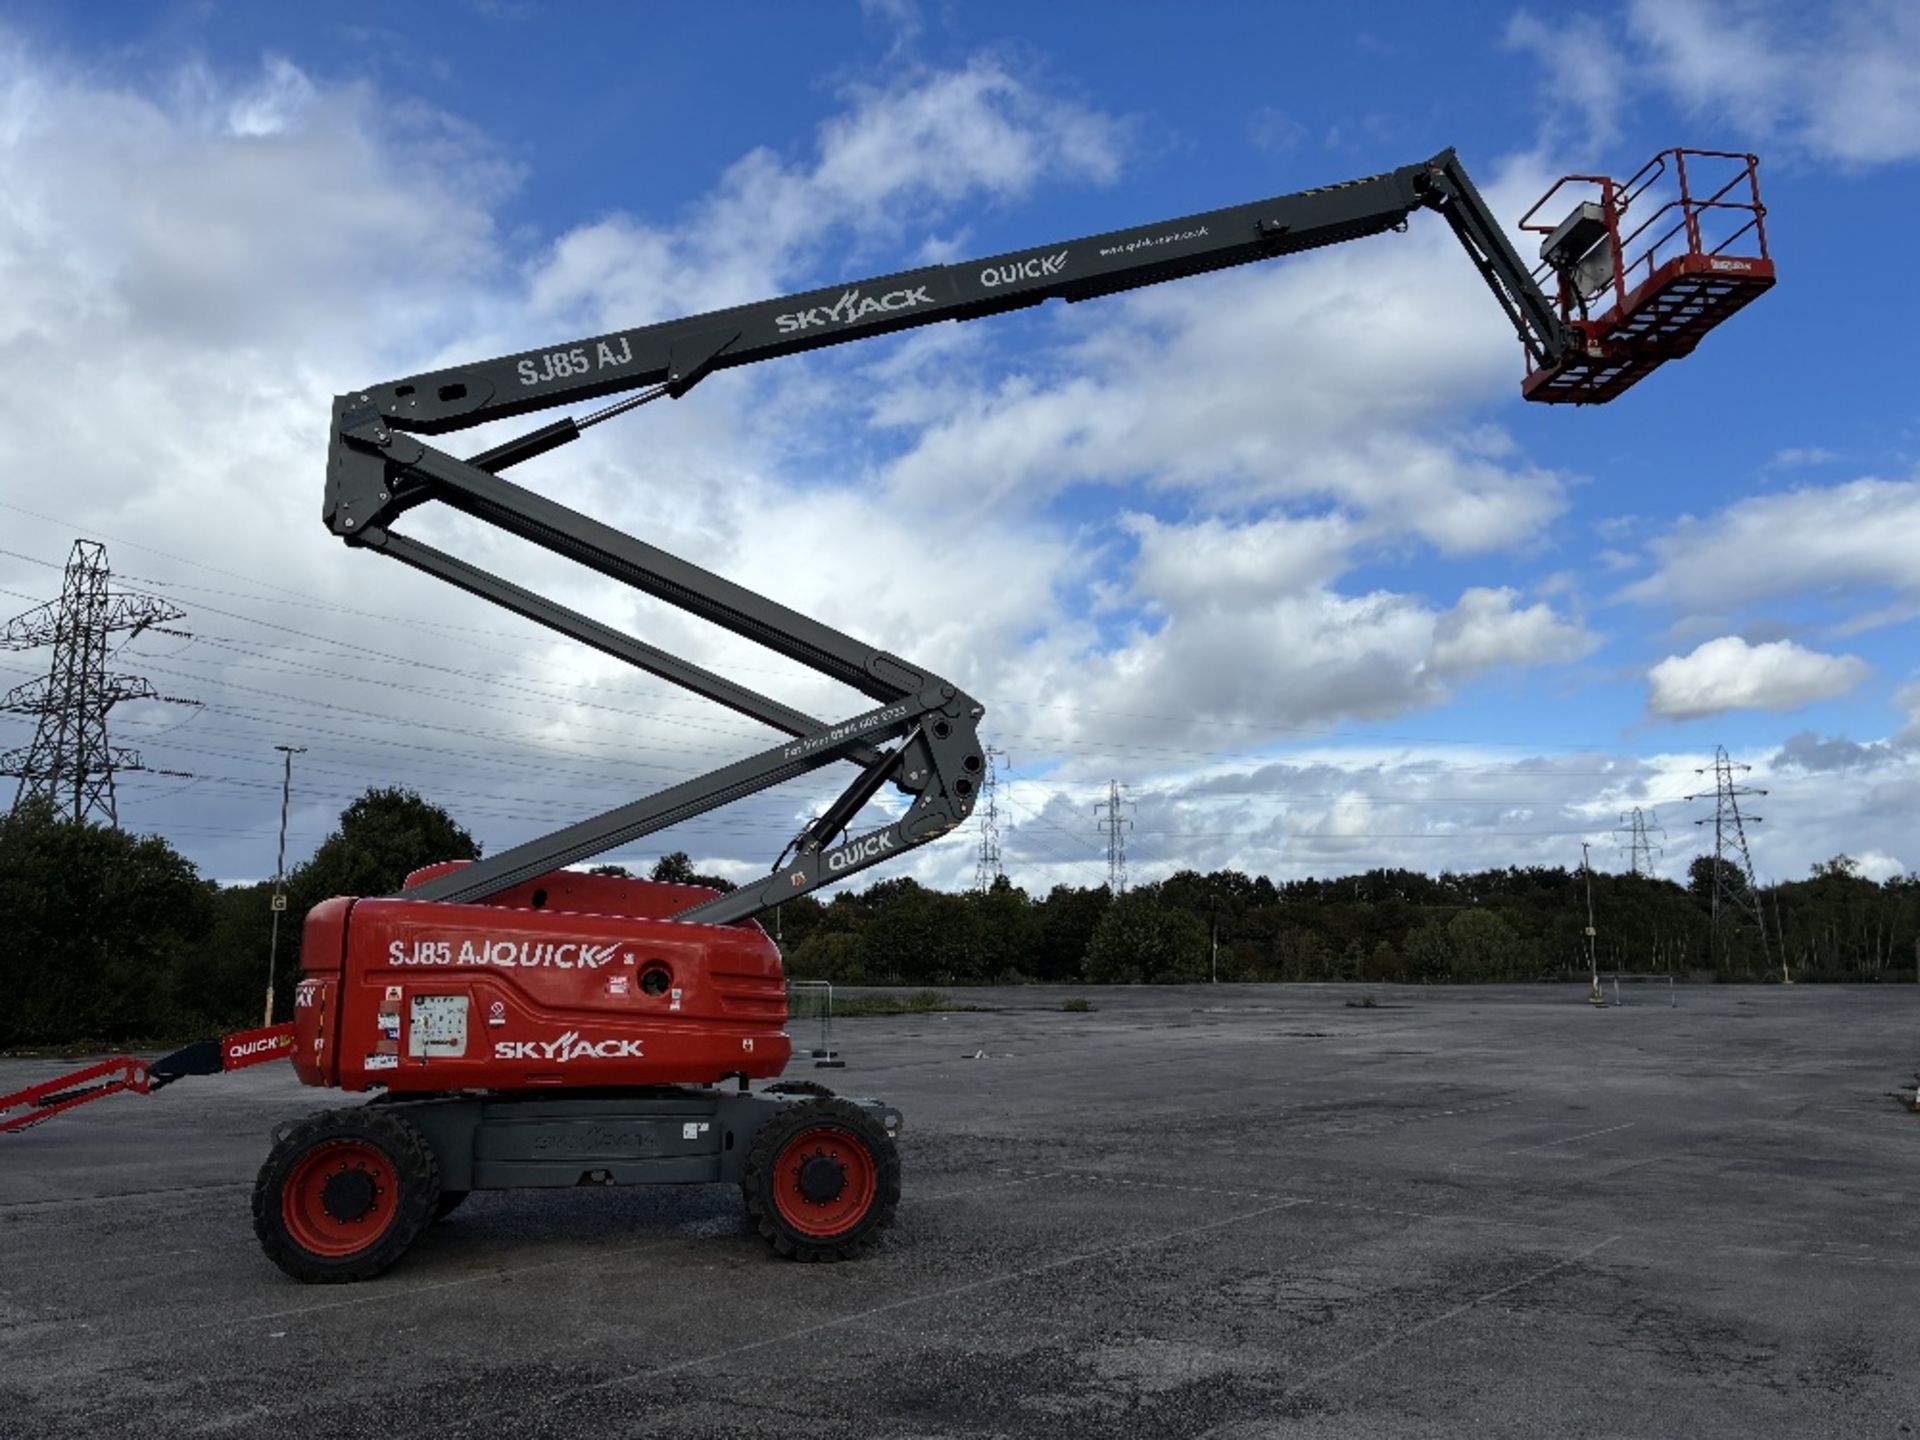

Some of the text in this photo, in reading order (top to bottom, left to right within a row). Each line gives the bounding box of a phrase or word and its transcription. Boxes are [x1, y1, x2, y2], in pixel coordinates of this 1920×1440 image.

[980, 250, 1069, 288] QUICK
[775, 286, 935, 333] SKYJACK
[518, 337, 632, 386] SJ85 AJ
[829, 831, 893, 870] QUICK
[388, 940, 491, 966] SJ85 AJ
[491, 942, 622, 969] QUICK
[229, 1036, 279, 1058] QUICK
[494, 1030, 644, 1063] SKYJACK
